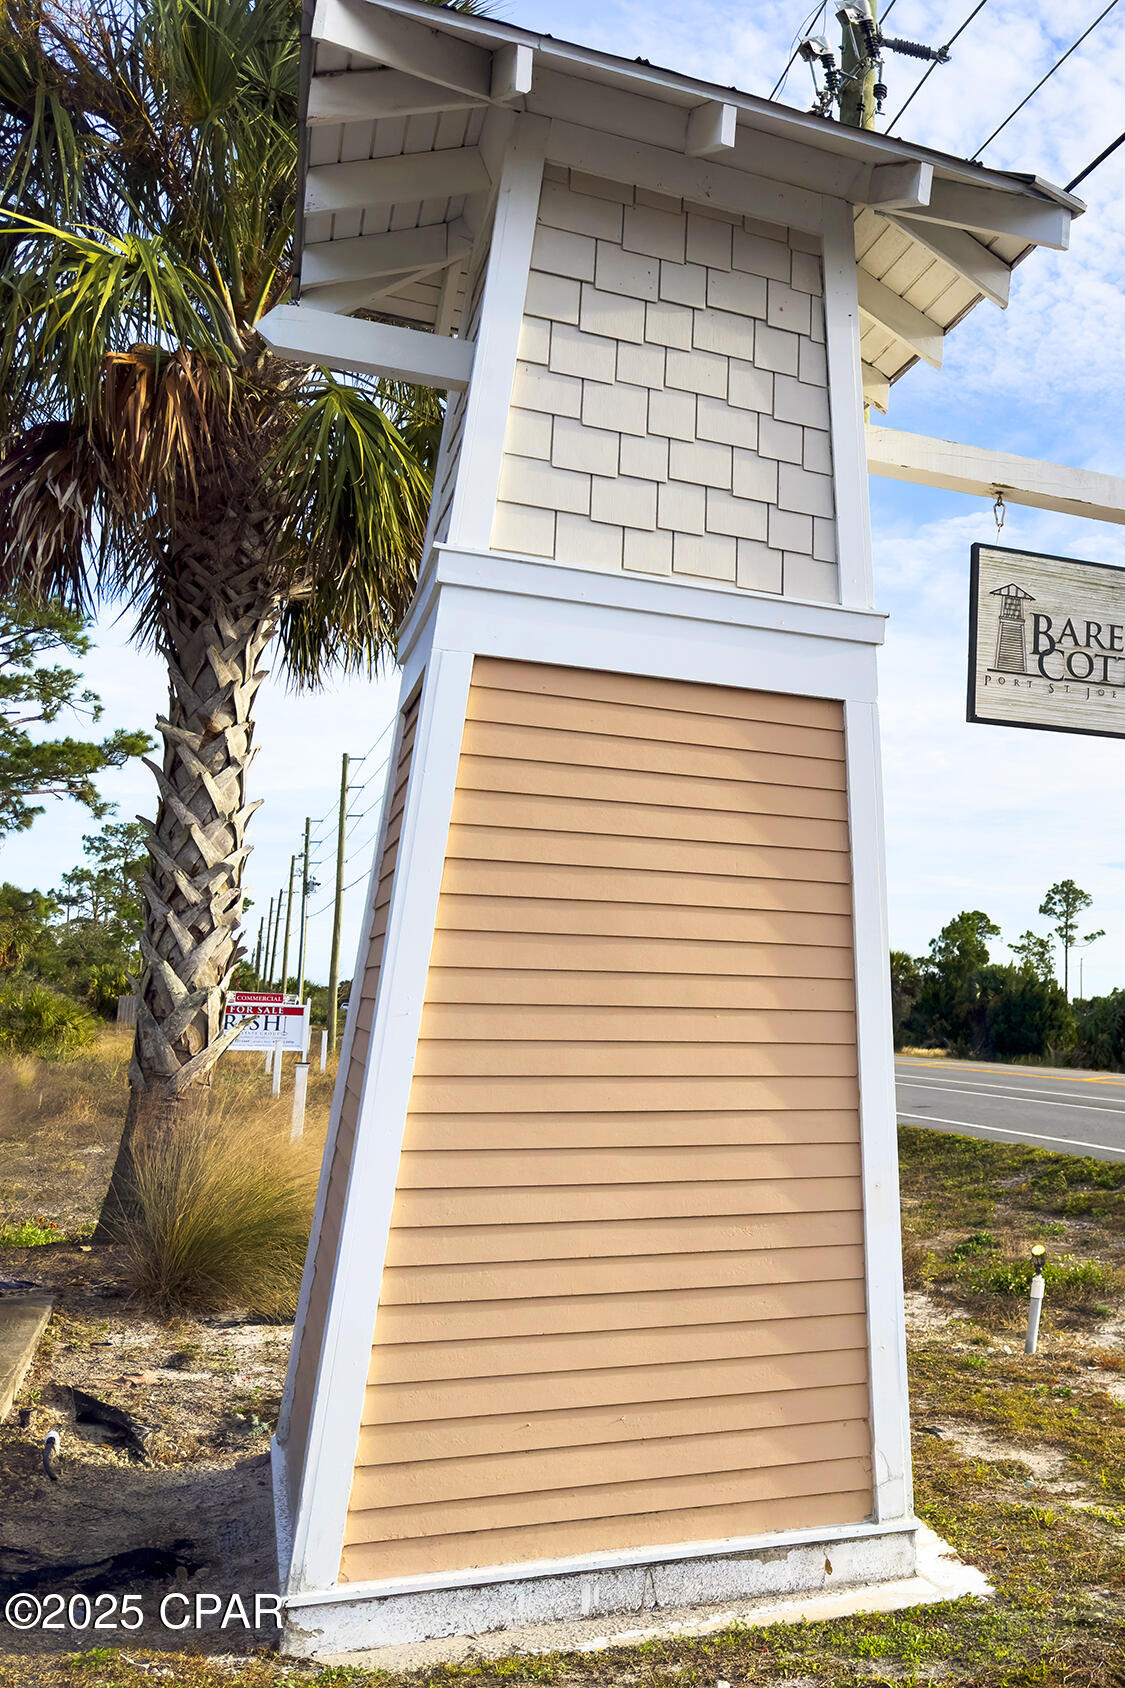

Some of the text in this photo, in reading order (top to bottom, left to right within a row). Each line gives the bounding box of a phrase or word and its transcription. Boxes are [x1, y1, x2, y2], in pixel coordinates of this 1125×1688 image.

[984, 674, 1033, 689] PORT
[1086, 687, 1118, 700] JOE
[230, 1006, 254, 1014] FOR
